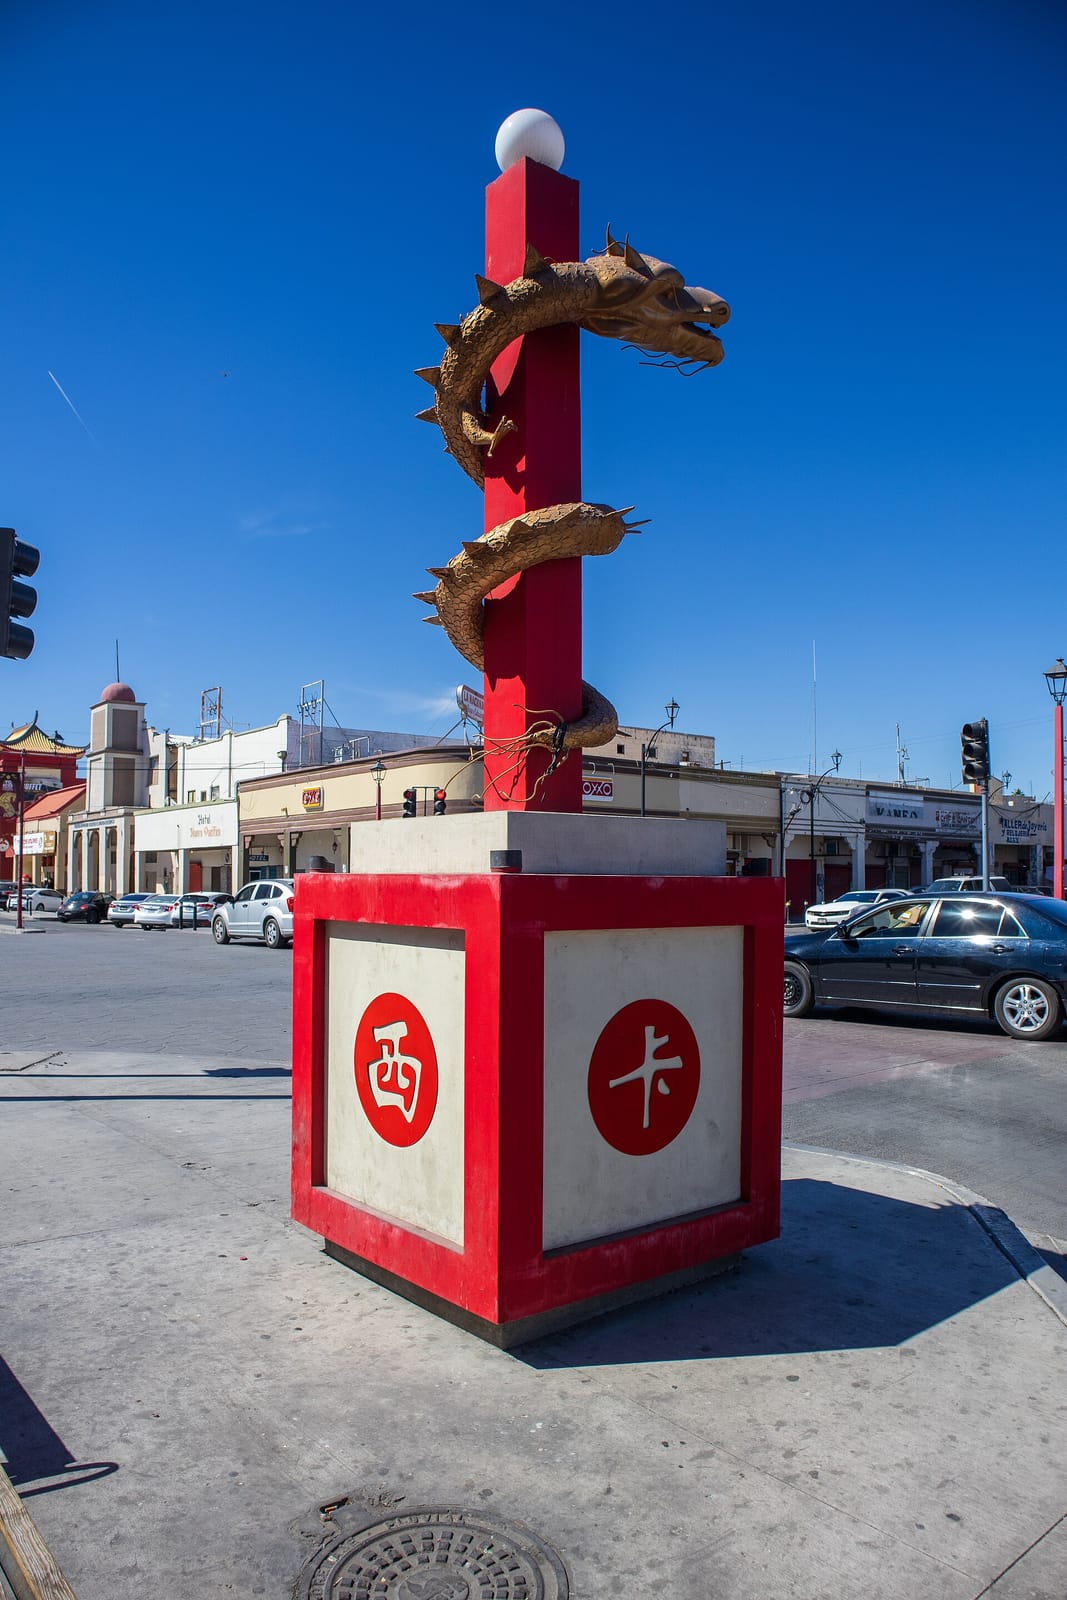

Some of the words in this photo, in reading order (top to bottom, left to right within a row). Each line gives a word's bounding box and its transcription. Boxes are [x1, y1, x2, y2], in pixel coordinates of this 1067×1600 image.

[582, 781, 612, 795] OXXO
[368, 1021, 422, 1123] 西
[608, 1025, 683, 1129] 卡
